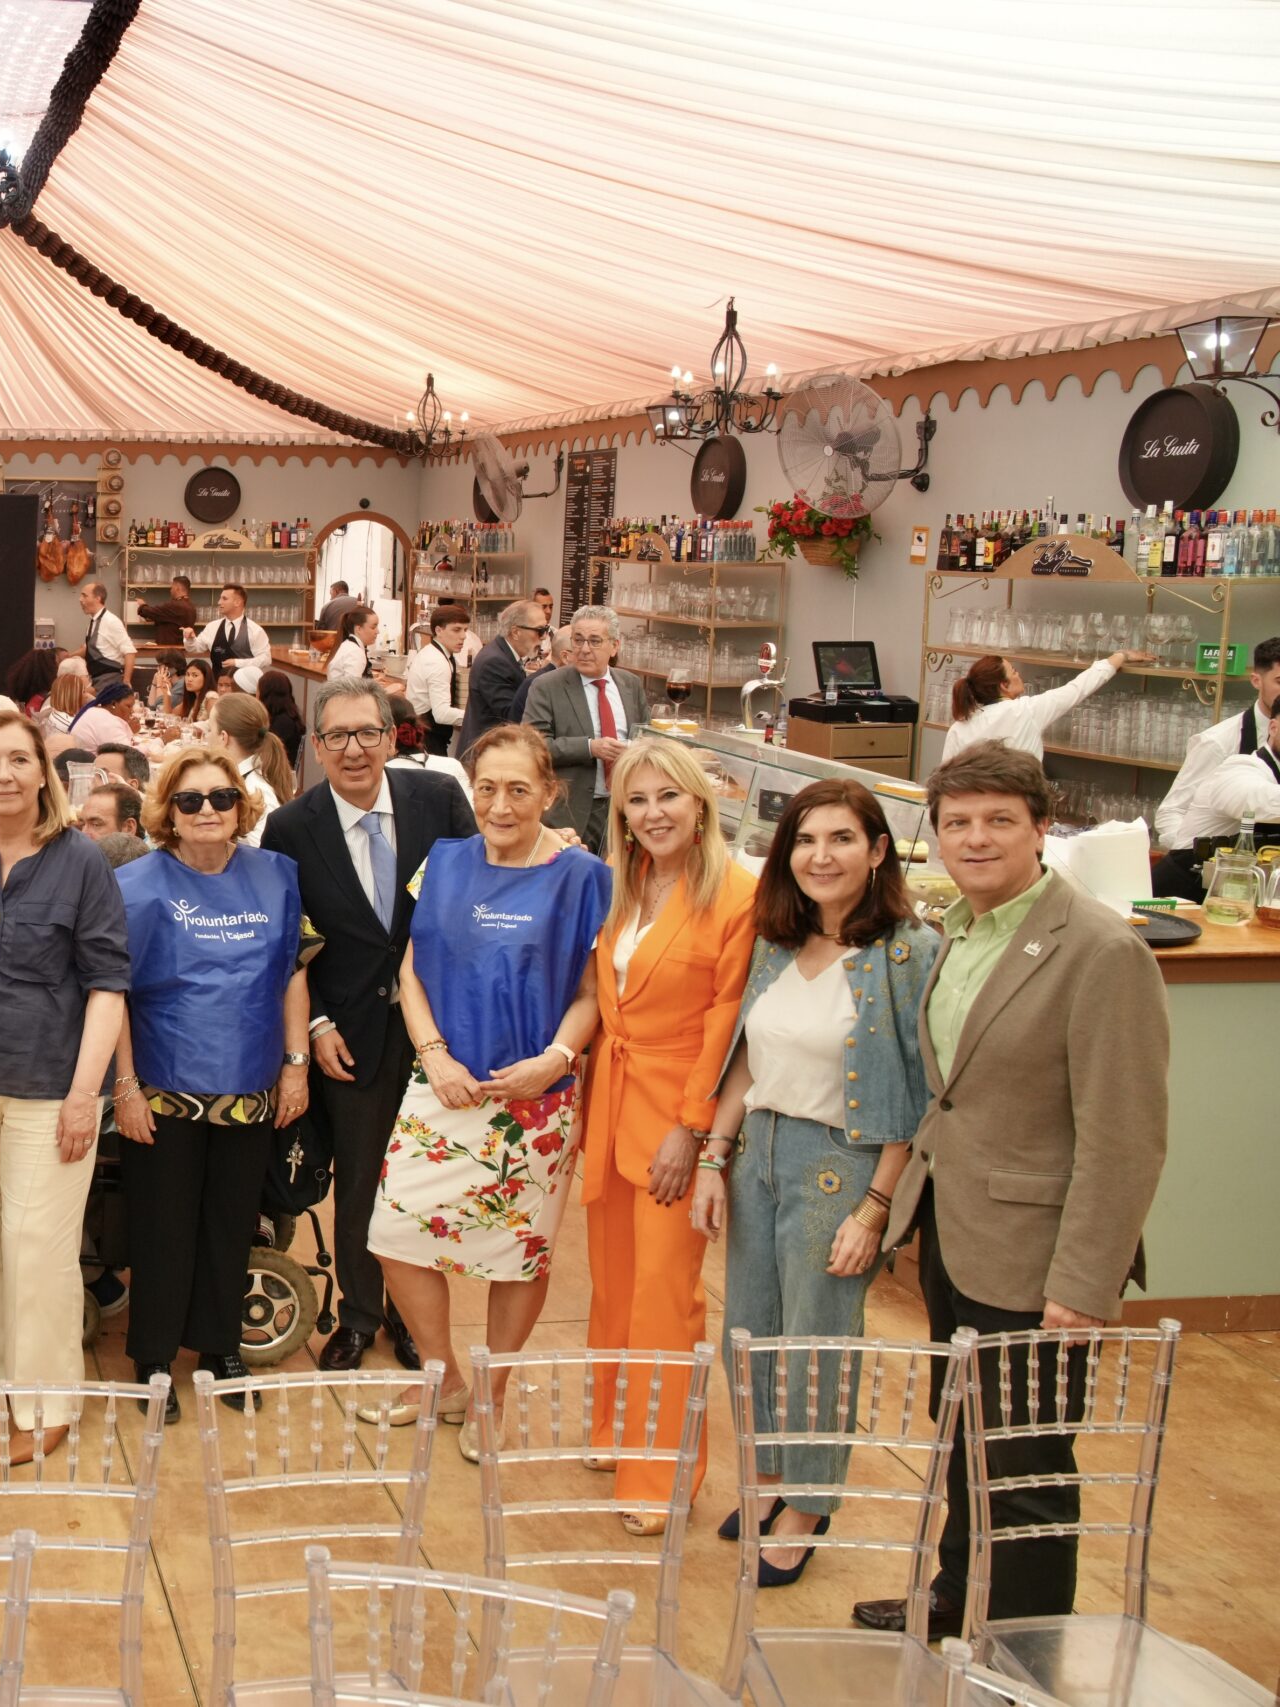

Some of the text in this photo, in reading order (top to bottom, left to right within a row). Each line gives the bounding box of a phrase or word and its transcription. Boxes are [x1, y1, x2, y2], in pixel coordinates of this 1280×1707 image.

[1139, 435, 1200, 459] La Guita
[196, 487, 209, 497] La
[187, 910, 269, 927] voluntariado
[481, 912, 533, 922] voluntariado
